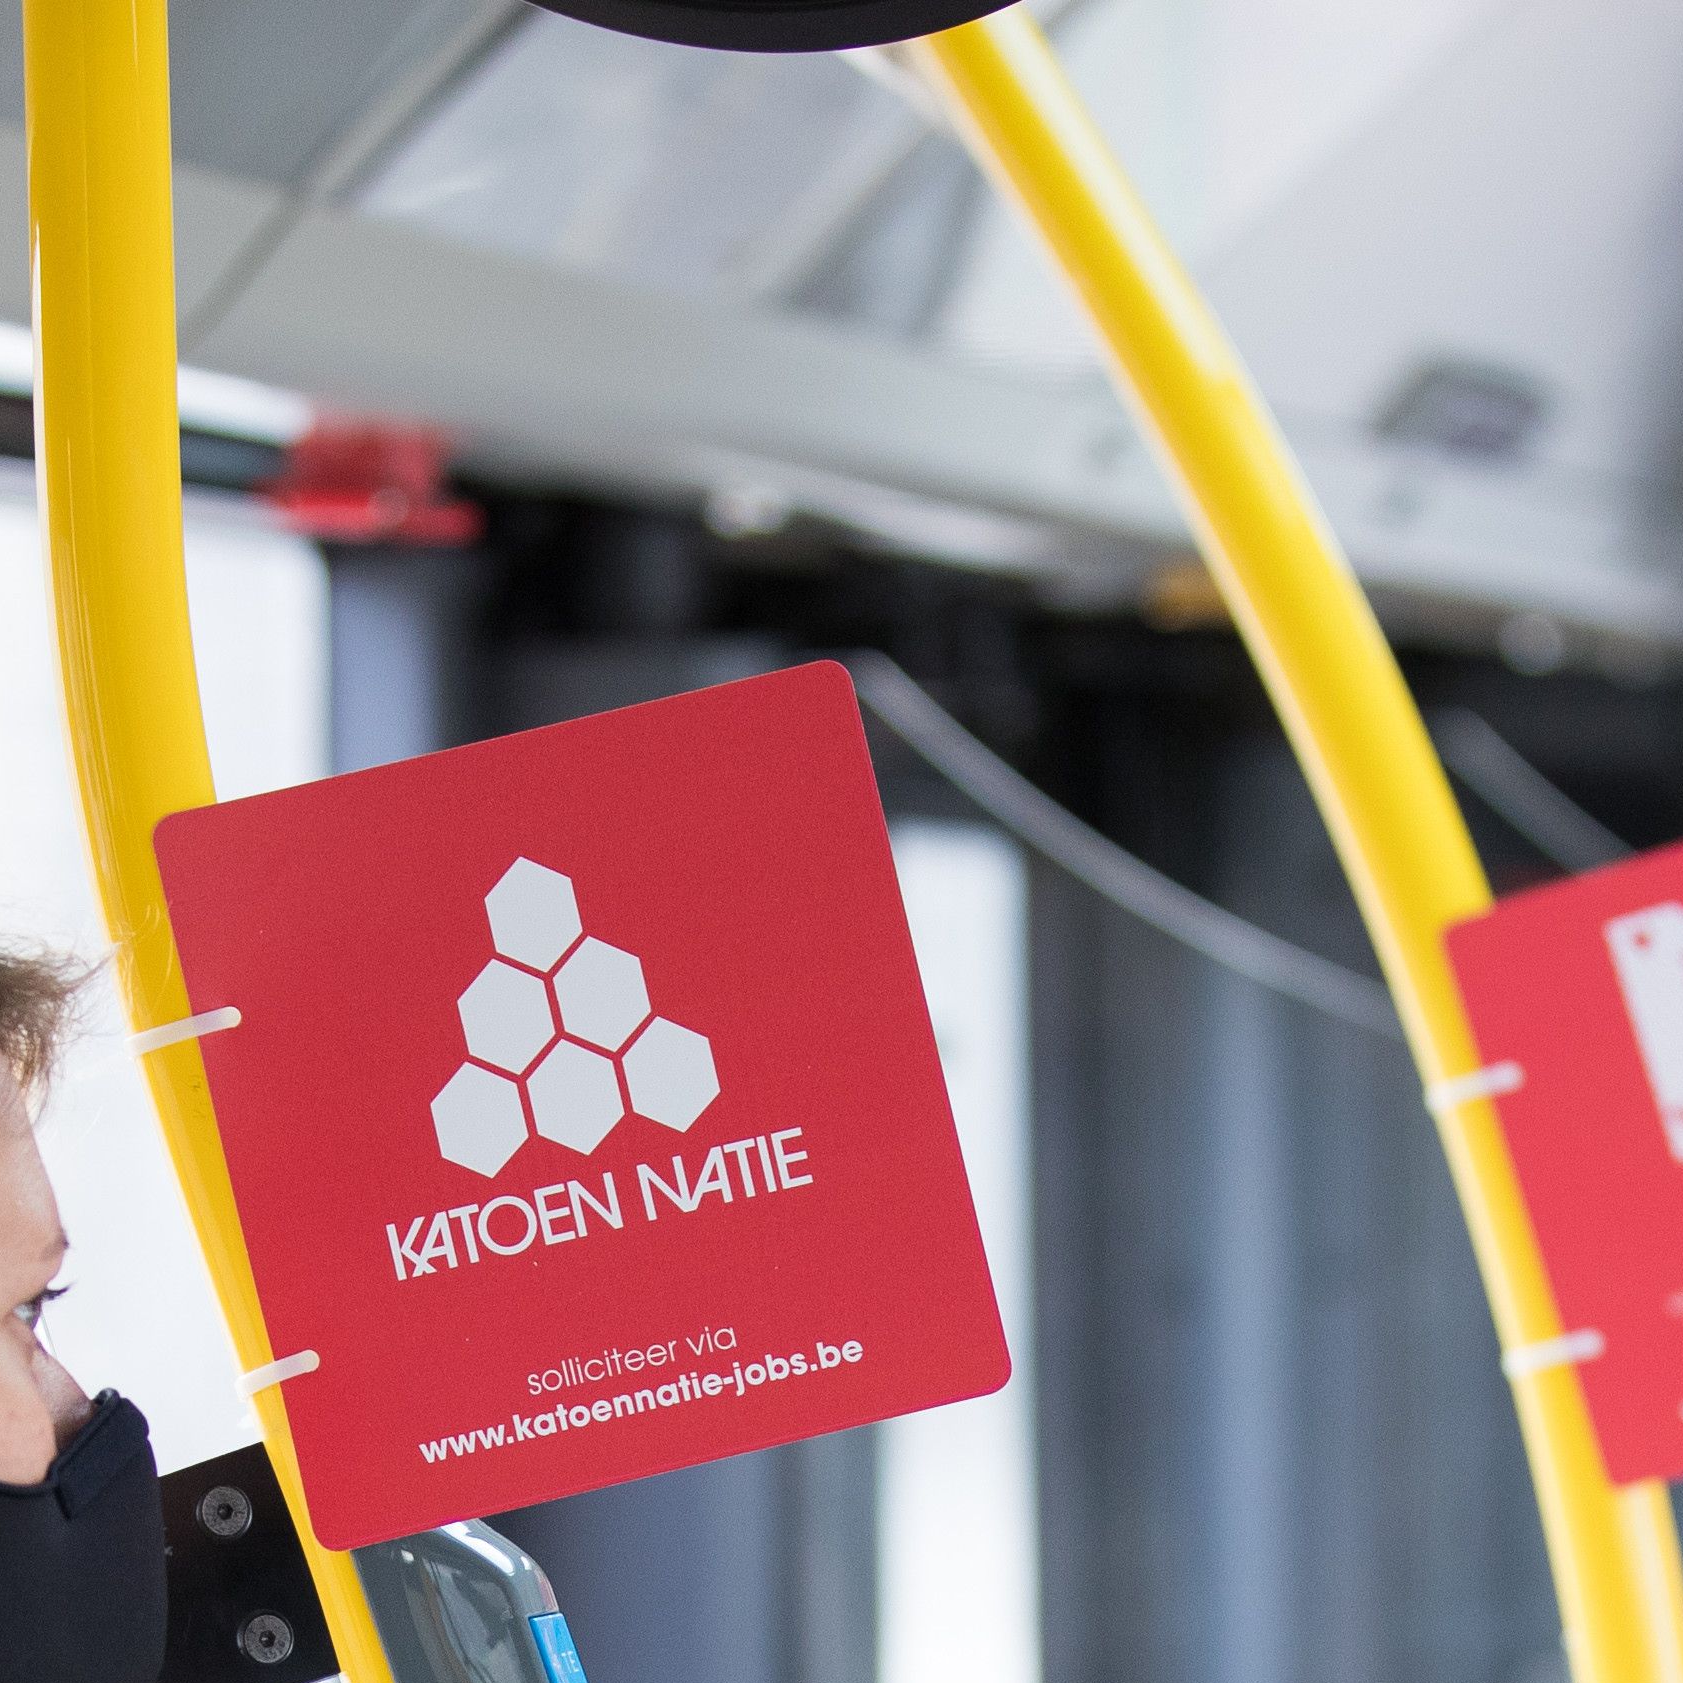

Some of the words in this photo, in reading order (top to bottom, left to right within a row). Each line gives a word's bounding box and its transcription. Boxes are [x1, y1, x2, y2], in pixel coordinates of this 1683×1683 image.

[385, 1171, 624, 1281] KATOEN
[636, 1127, 814, 1221] NATIE
[418, 1340, 865, 1464] www.katoennatie-jobs.be
[526, 1339, 678, 1396] solliciteer
[685, 1326, 738, 1356] via
